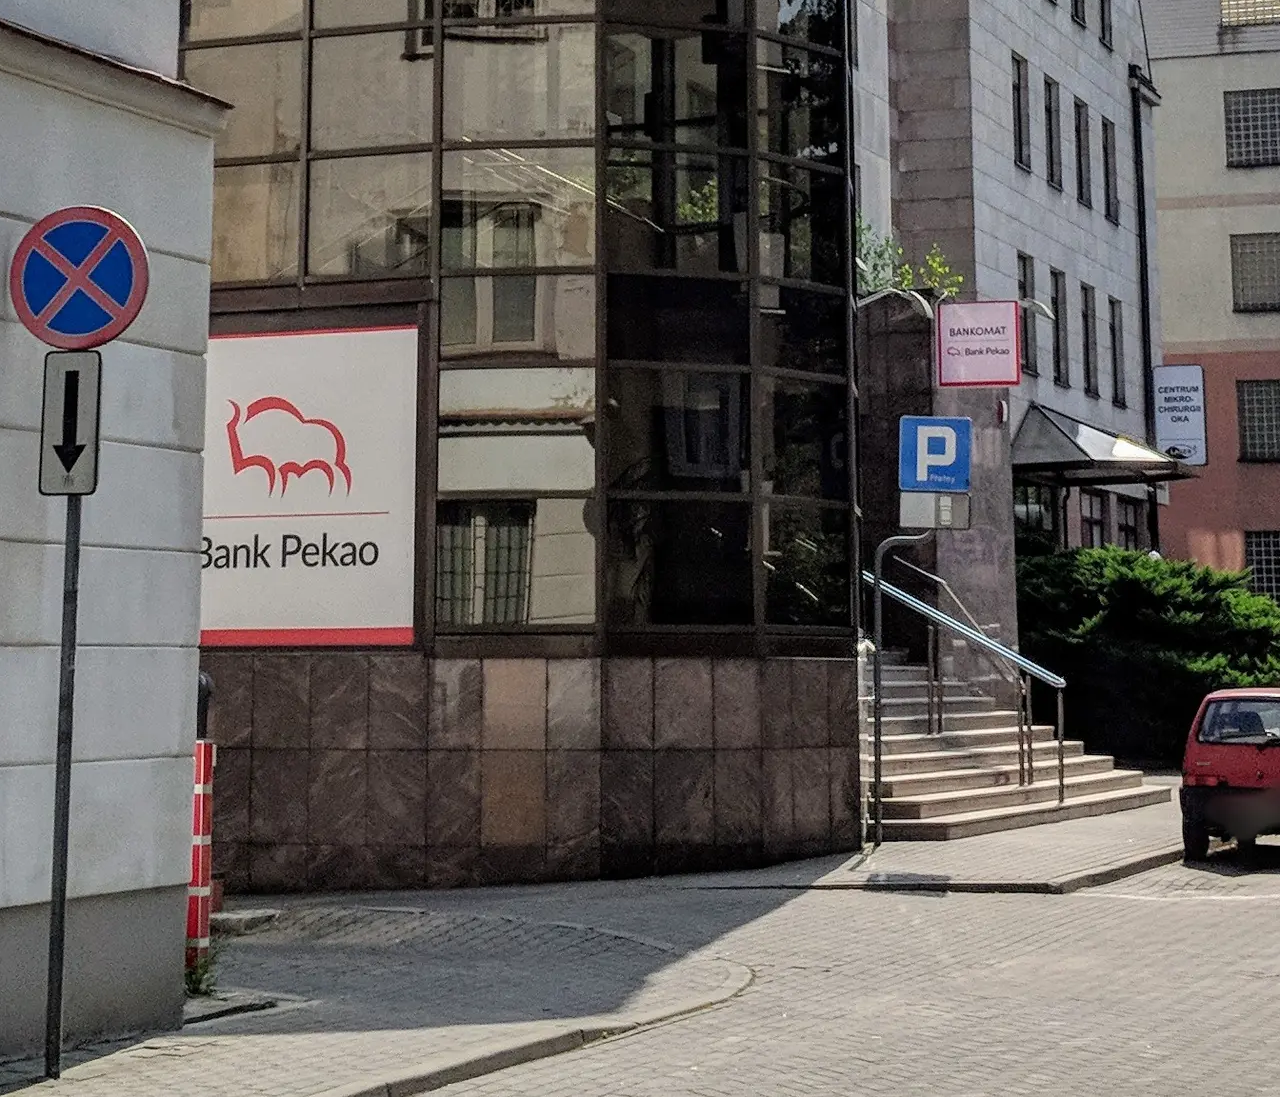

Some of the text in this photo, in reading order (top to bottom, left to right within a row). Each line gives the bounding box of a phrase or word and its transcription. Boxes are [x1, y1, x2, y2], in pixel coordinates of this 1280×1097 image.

[949, 326, 1007, 337] BANKOMAT
[964, 347, 1010, 356] Bank Pekao
[1158, 386, 1200, 394] CENTRUM
[1164, 395, 1194, 403] MIKRO-
[1170, 415, 1190, 423] OKA
[917, 425, 956, 482] P
[201, 532, 380, 569] Bank Pekao
